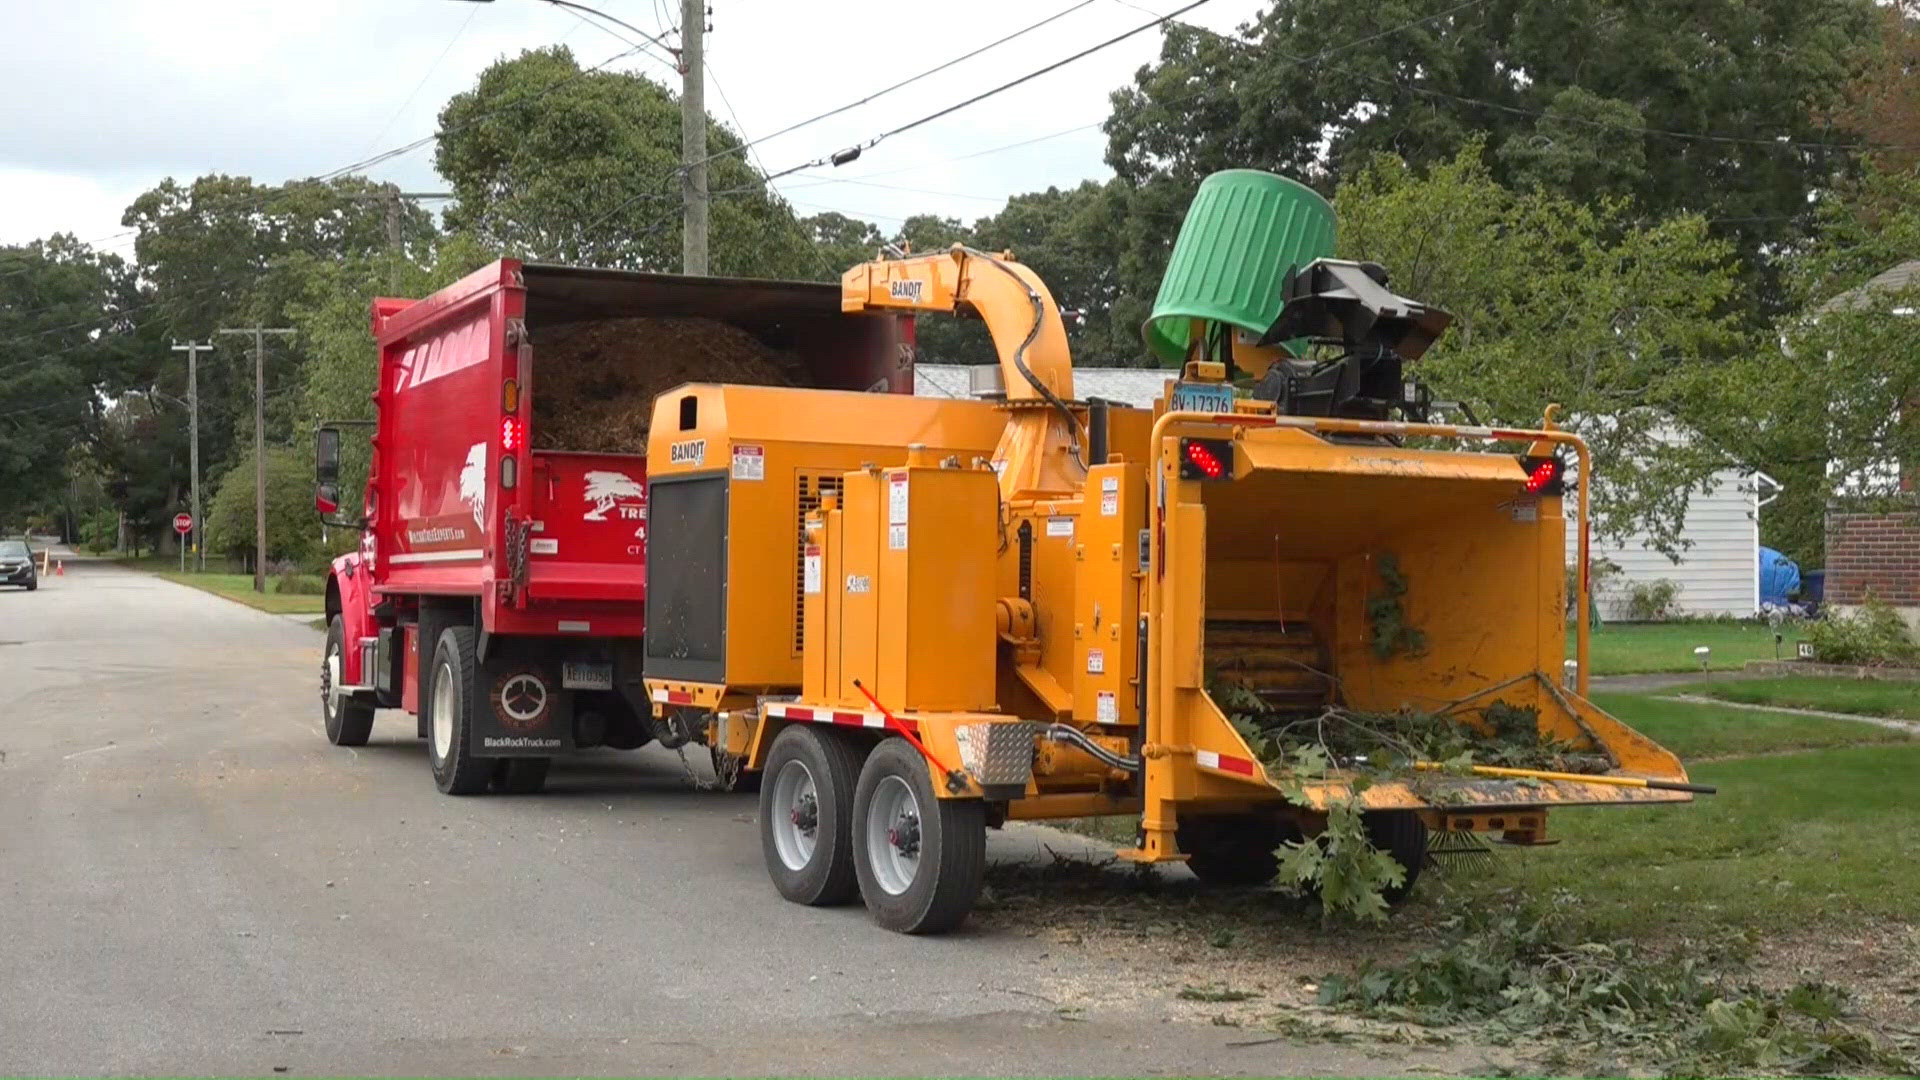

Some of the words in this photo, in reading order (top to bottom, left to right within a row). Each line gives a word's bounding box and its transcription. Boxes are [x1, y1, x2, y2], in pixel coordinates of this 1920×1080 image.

[891, 281, 922, 297] BANDIT
[671, 441, 705, 461] BANDIT
[175, 519, 191, 527] STOP
[484, 737, 561, 748] BlackRockTruck.com
